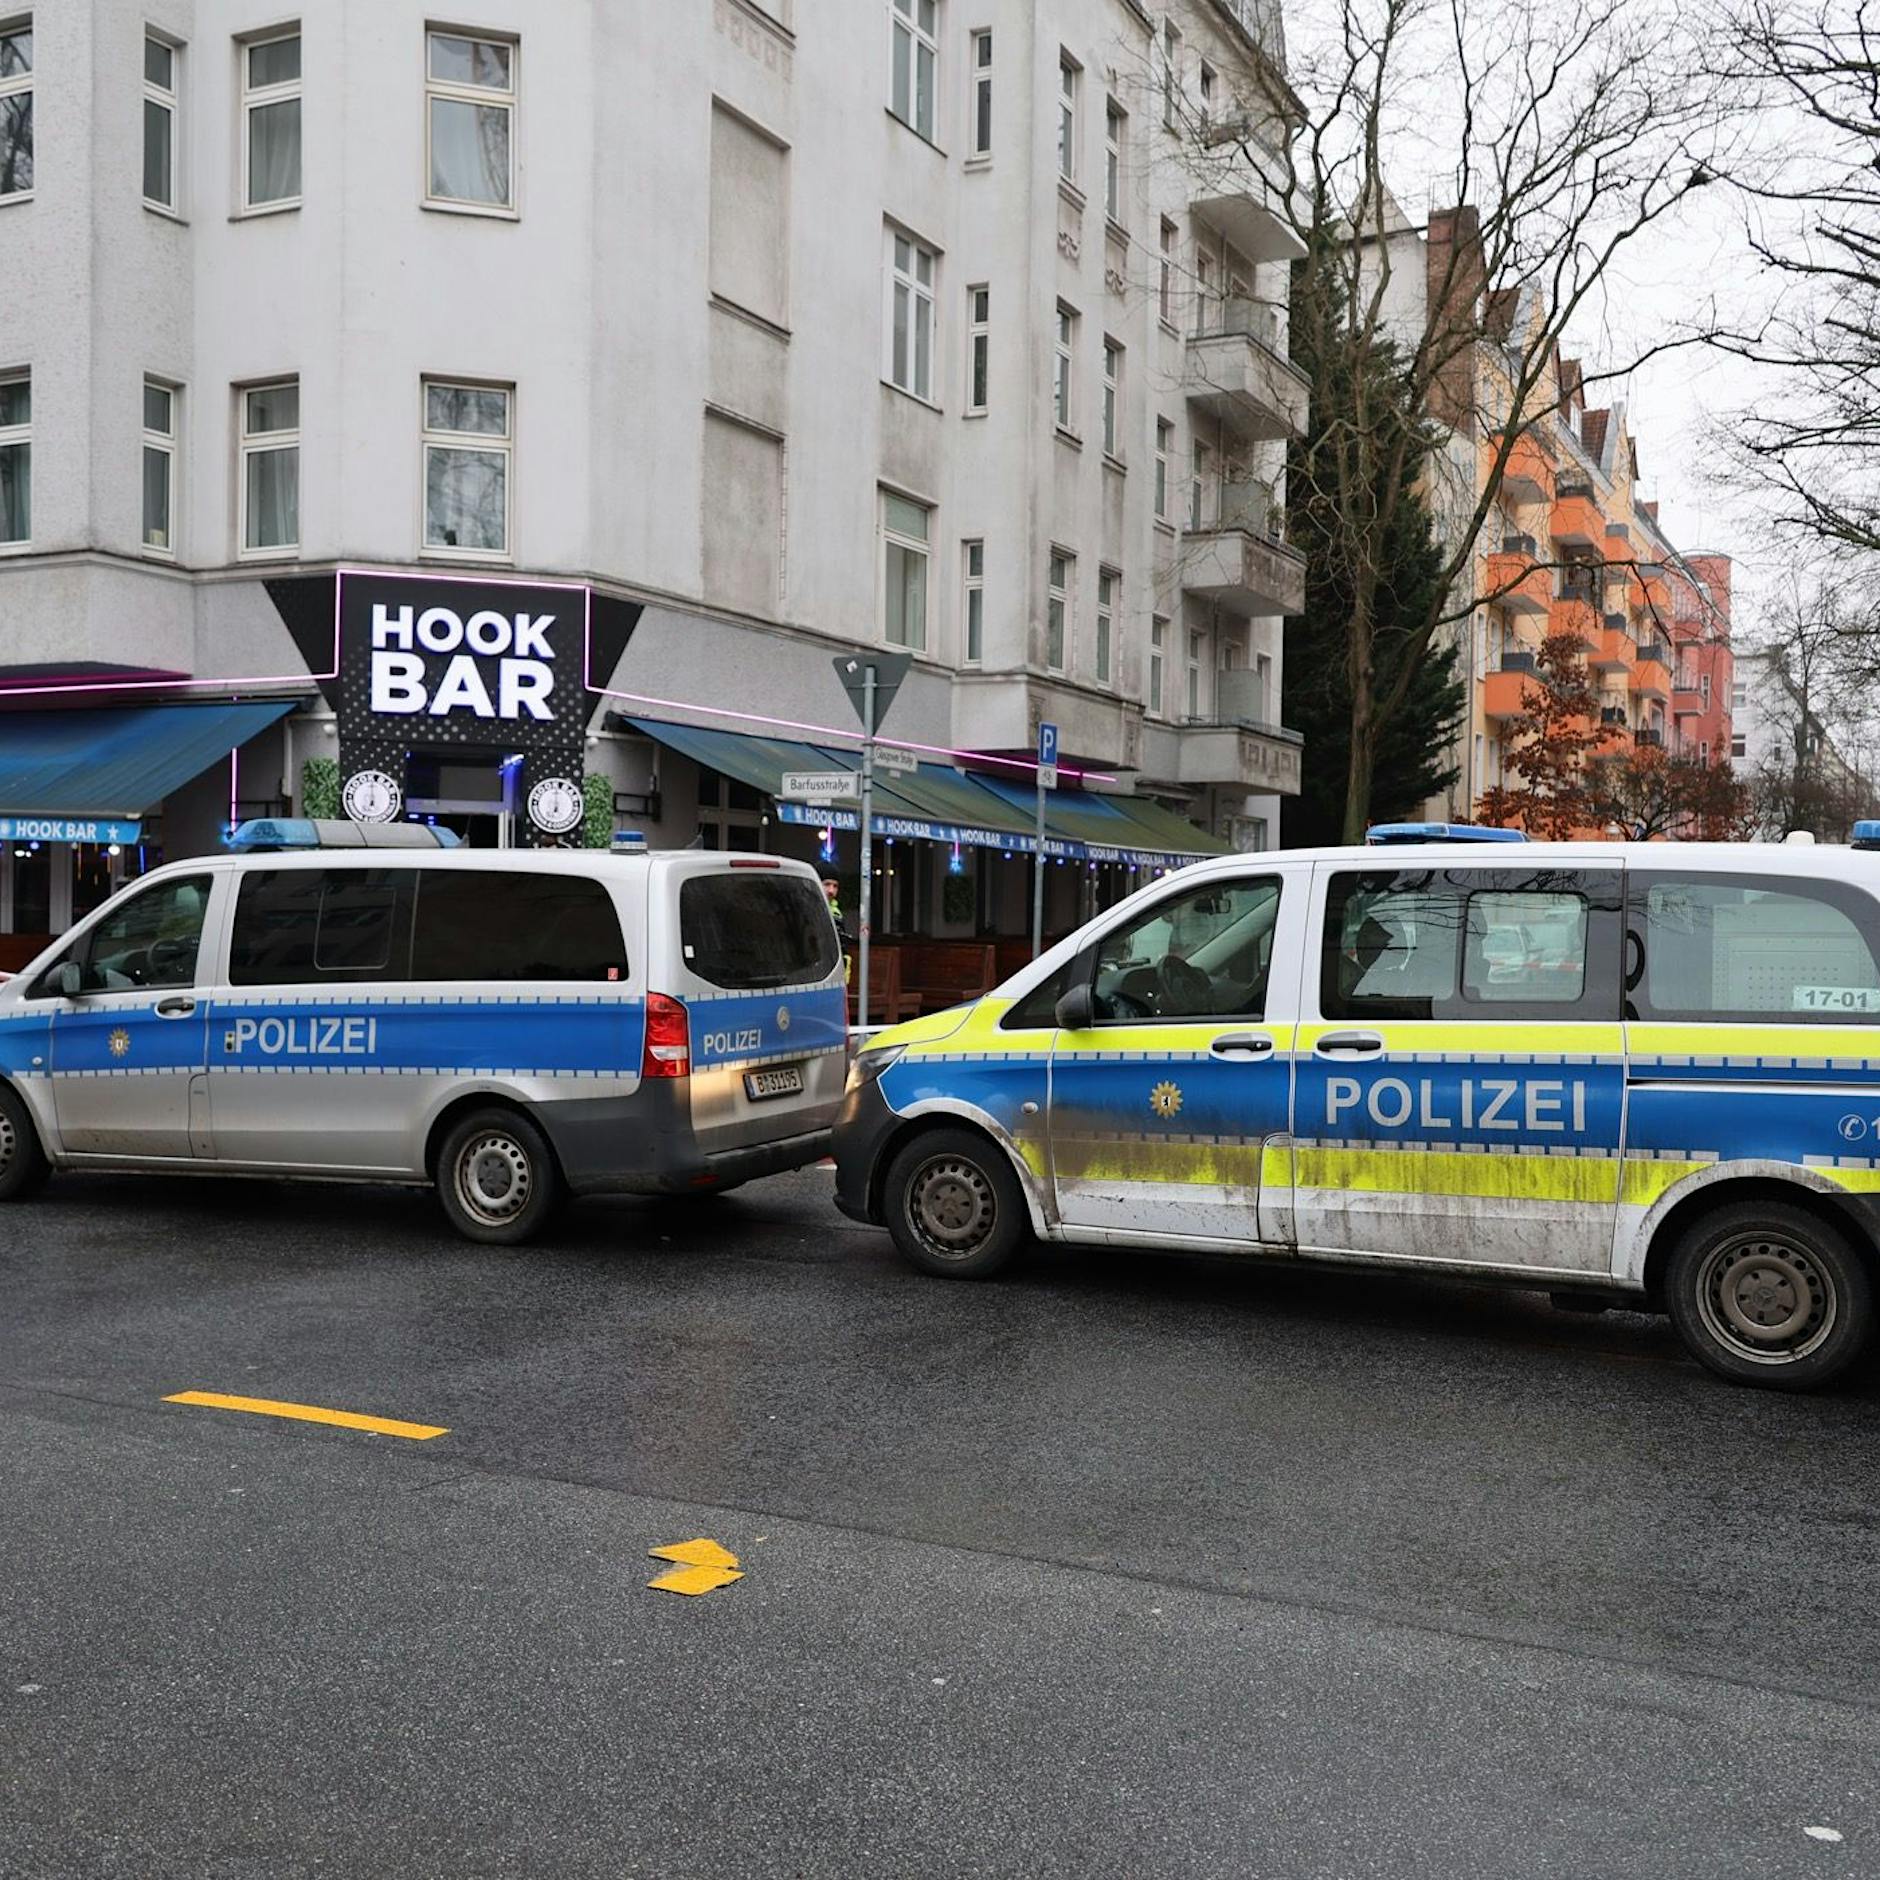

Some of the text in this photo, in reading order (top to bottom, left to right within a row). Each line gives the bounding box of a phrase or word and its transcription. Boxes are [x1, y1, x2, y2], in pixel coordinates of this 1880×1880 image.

[372, 604, 557, 659] HOOK
[371, 650, 558, 720] BAR
[1042, 728, 1054, 760] P
[790, 778, 850, 792] Barfusstraße
[804, 807, 858, 830] HOOK BAR
[887, 818, 931, 838] HOOK BAR
[15, 820, 97, 839] HOOK BAR
[959, 829, 1001, 847] HOOK BAR
[1051, 842, 1065, 856] BAR
[1805, 989, 1868, 1008] 17-01
[235, 1017, 377, 1054] POLIZEI
[704, 1028, 762, 1056] POLIZEI
[769, 1070, 797, 1090] 31195
[1326, 1076, 1586, 1132] POLIZEI
